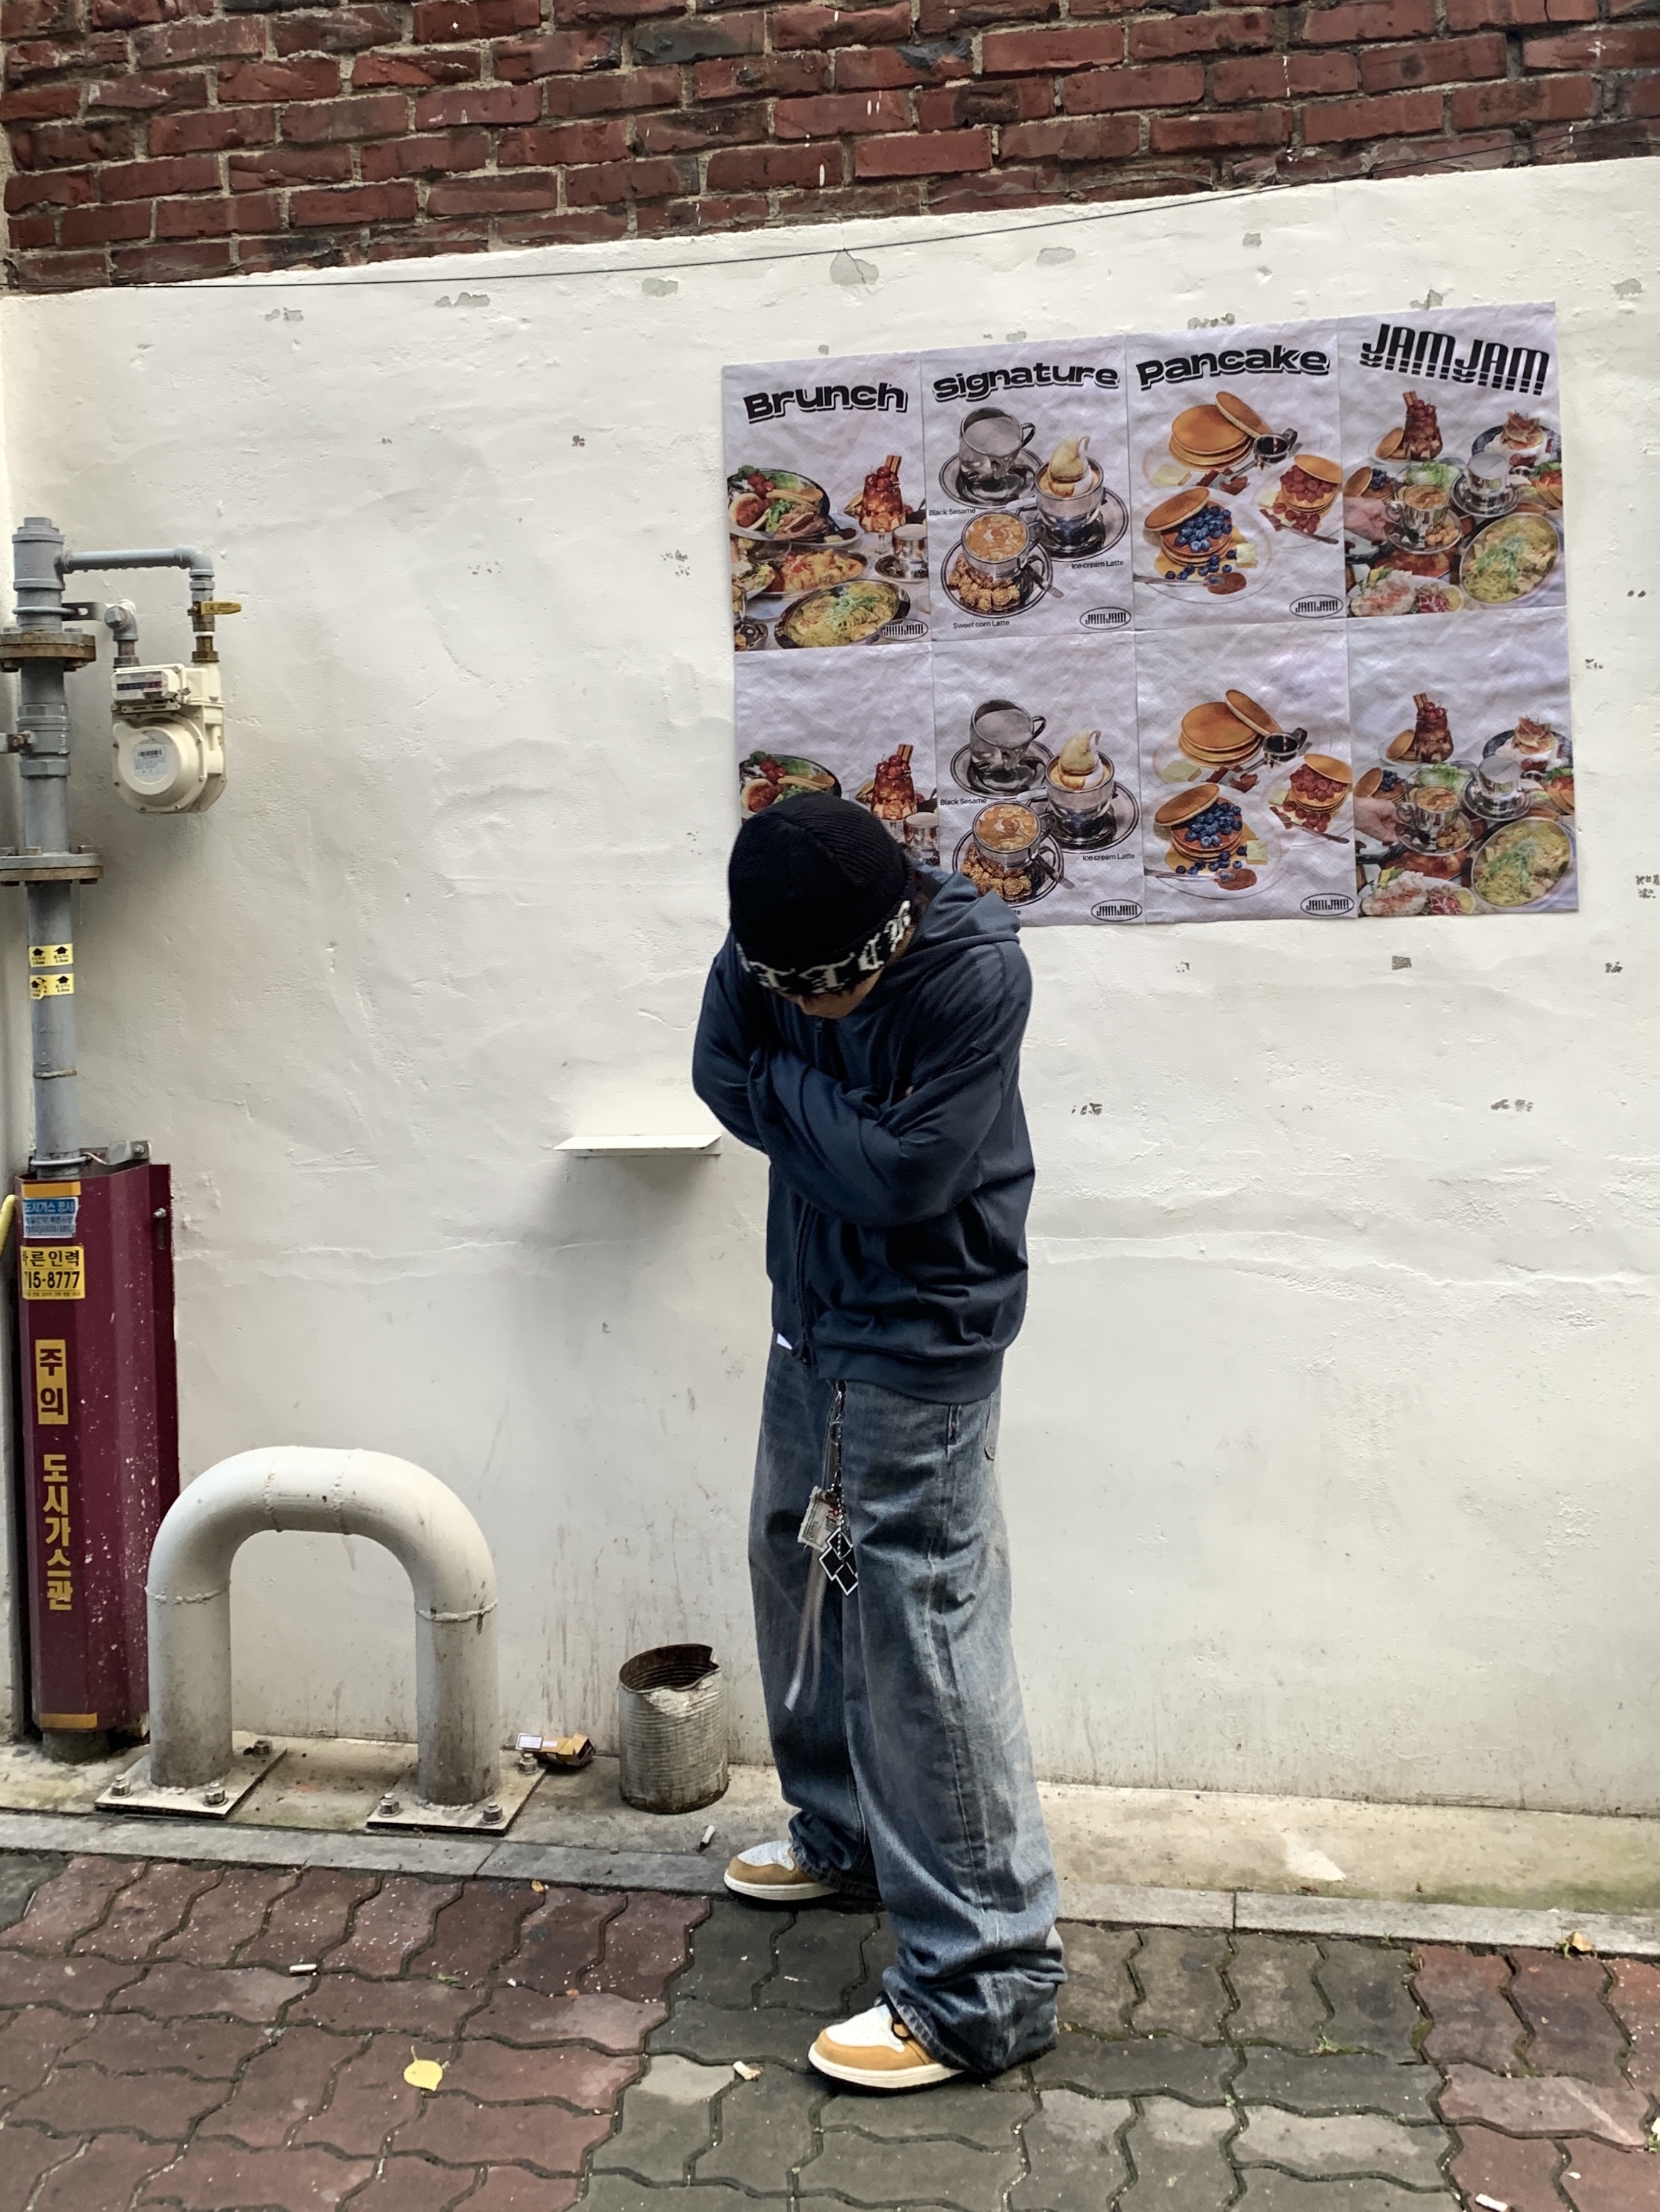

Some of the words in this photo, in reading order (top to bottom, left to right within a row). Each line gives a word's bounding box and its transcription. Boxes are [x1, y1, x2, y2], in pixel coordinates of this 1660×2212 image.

[1135, 345, 1330, 391] Pancake
[1359, 323, 1550, 396] JAMJAM
[743, 382, 909, 425] Brunch
[1085, 612, 1127, 625] JAMJAM
[1295, 599, 1339, 613] JAMJAM
[1096, 905, 1138, 917] JAMJAM
[1305, 898, 1350, 911] JAMJAM
[39, 1348, 64, 1416] 주의
[42, 1453, 74, 1611] 도시가스관
